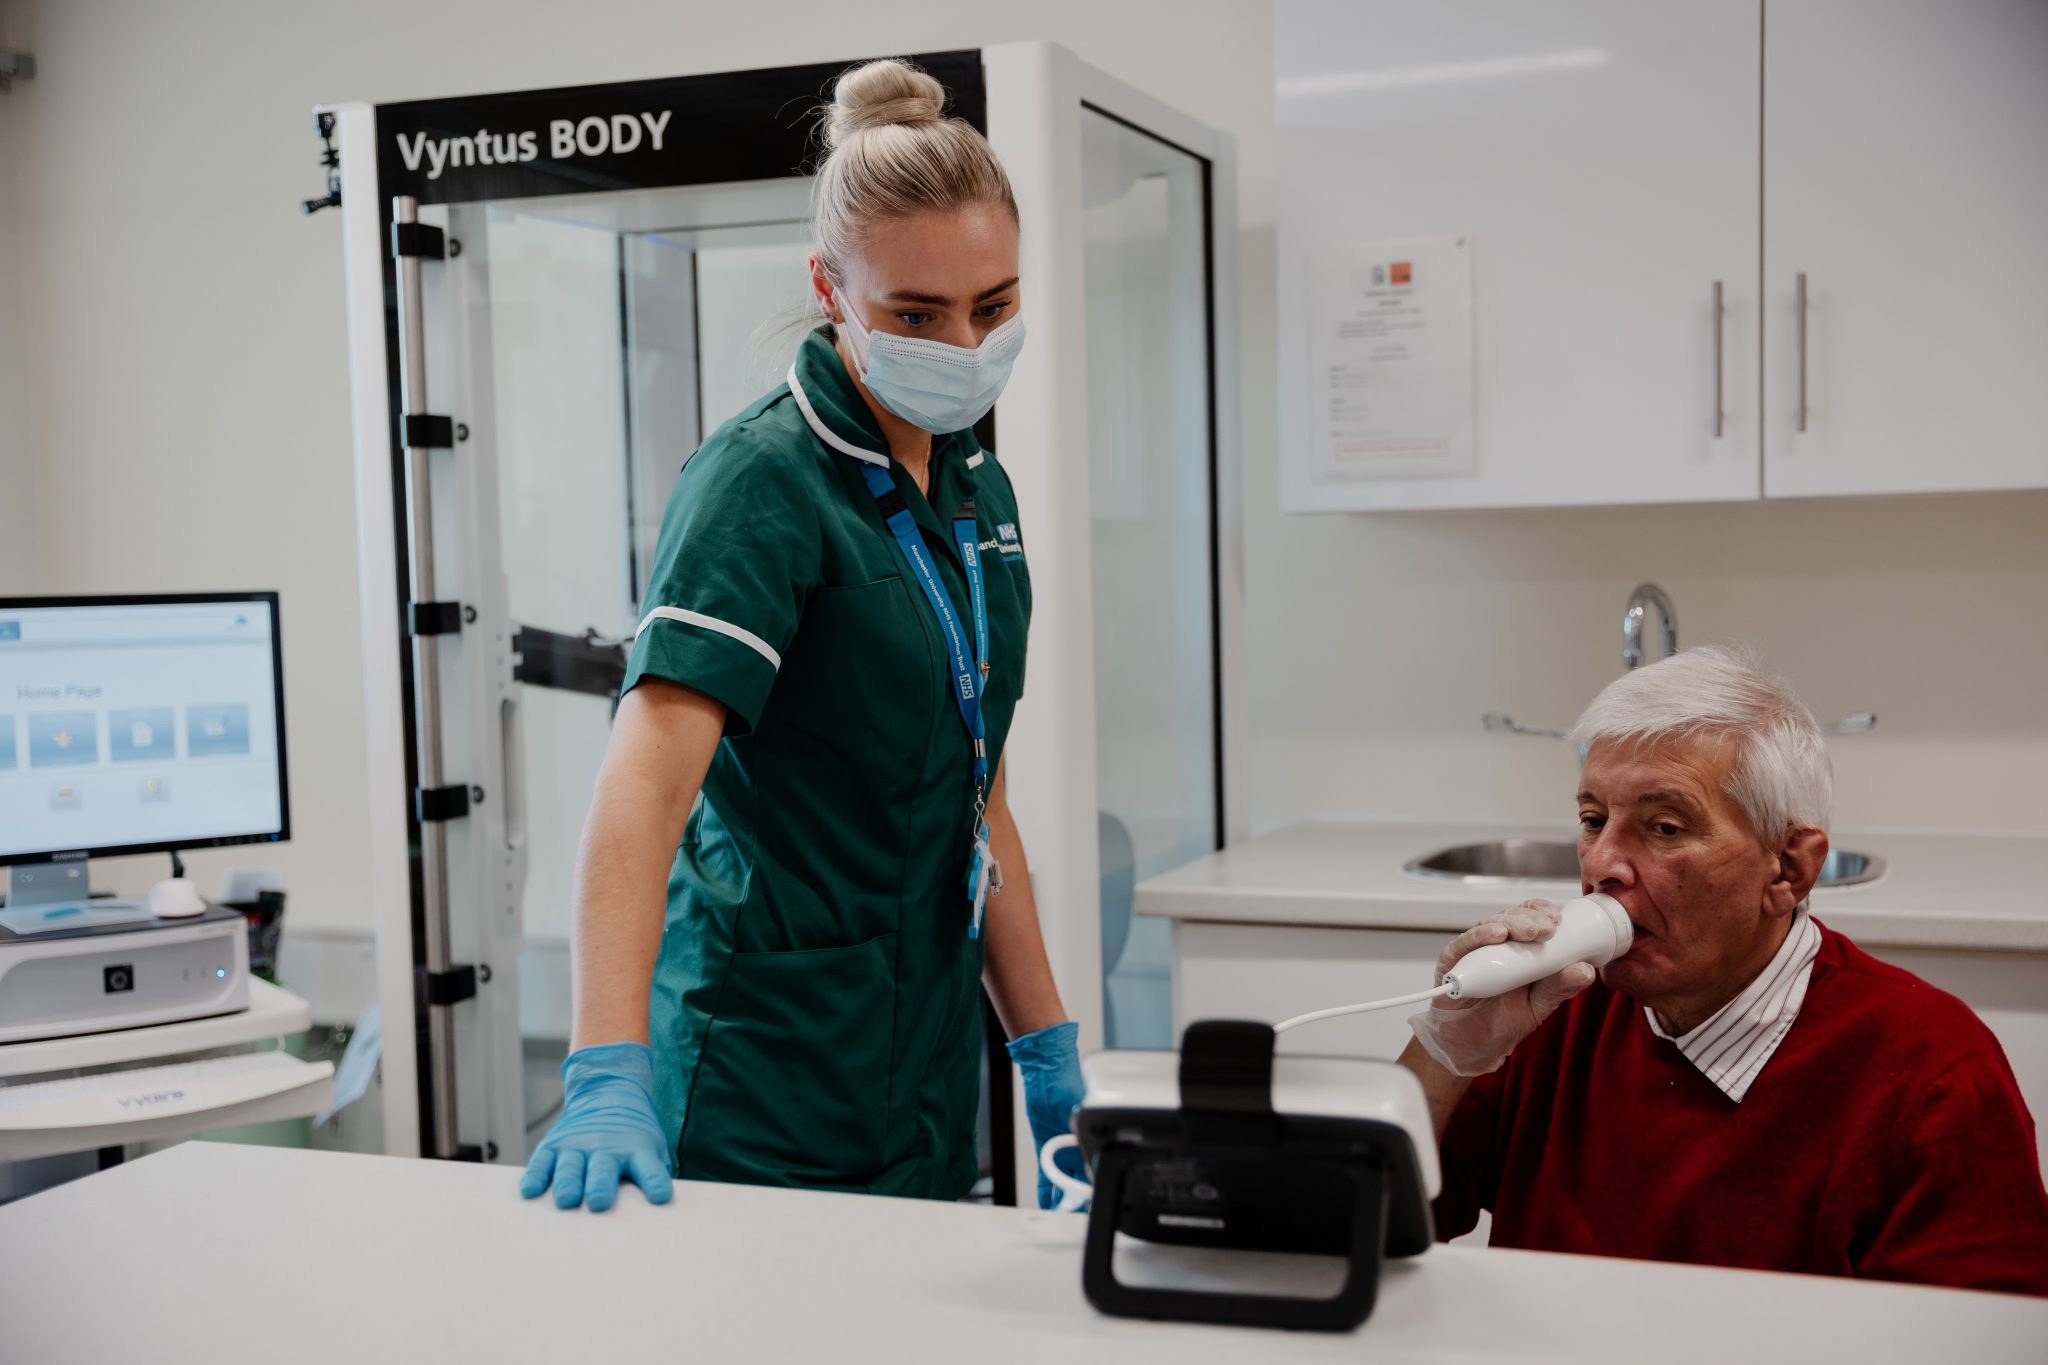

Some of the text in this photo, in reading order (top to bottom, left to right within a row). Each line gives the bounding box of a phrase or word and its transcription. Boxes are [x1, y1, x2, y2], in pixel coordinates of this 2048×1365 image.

[396, 110, 673, 180] Vyntus BODY
[963, 543, 977, 566] NHS
[911, 544, 966, 672] Manchester University NHS Foundation Trust
[960, 675, 974, 698] NHS
